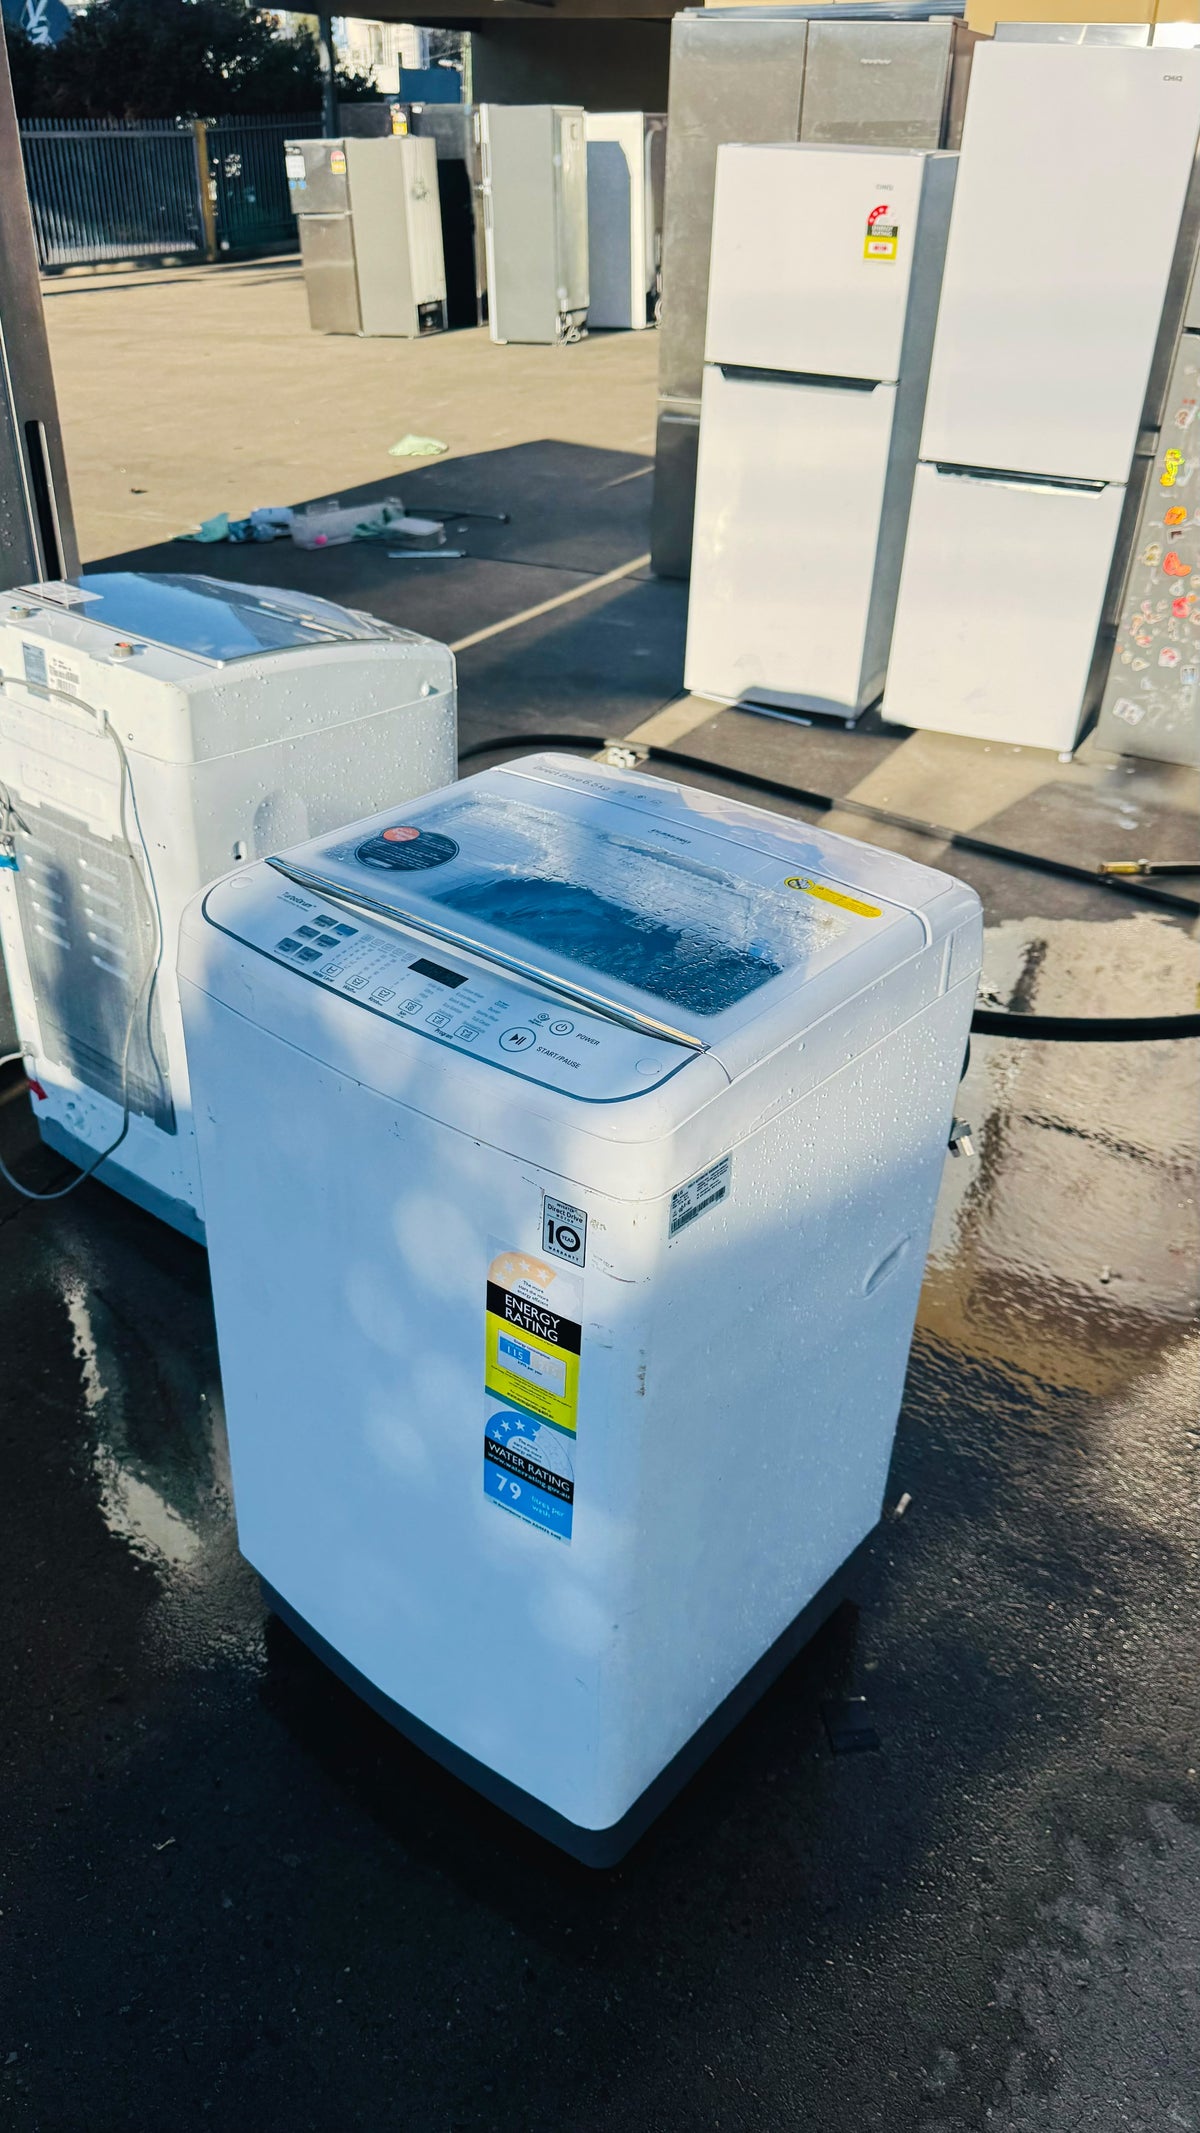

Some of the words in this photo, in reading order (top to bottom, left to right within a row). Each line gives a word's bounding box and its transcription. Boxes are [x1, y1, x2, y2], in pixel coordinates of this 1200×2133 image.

[576, 1032, 601, 1047] POWER
[536, 1046, 582, 1069] START/PAUSE
[547, 1203, 567, 1217] Direct
[566, 1211, 584, 1224] Drive
[547, 1219, 581, 1252] 10
[505, 1294, 560, 1329] ENERGY
[505, 1307, 559, 1342] RATING
[507, 1345, 524, 1360] 115
[488, 1441, 525, 1469] WATER
[528, 1463, 570, 1492] RATING
[496, 1472, 522, 1500] 79
